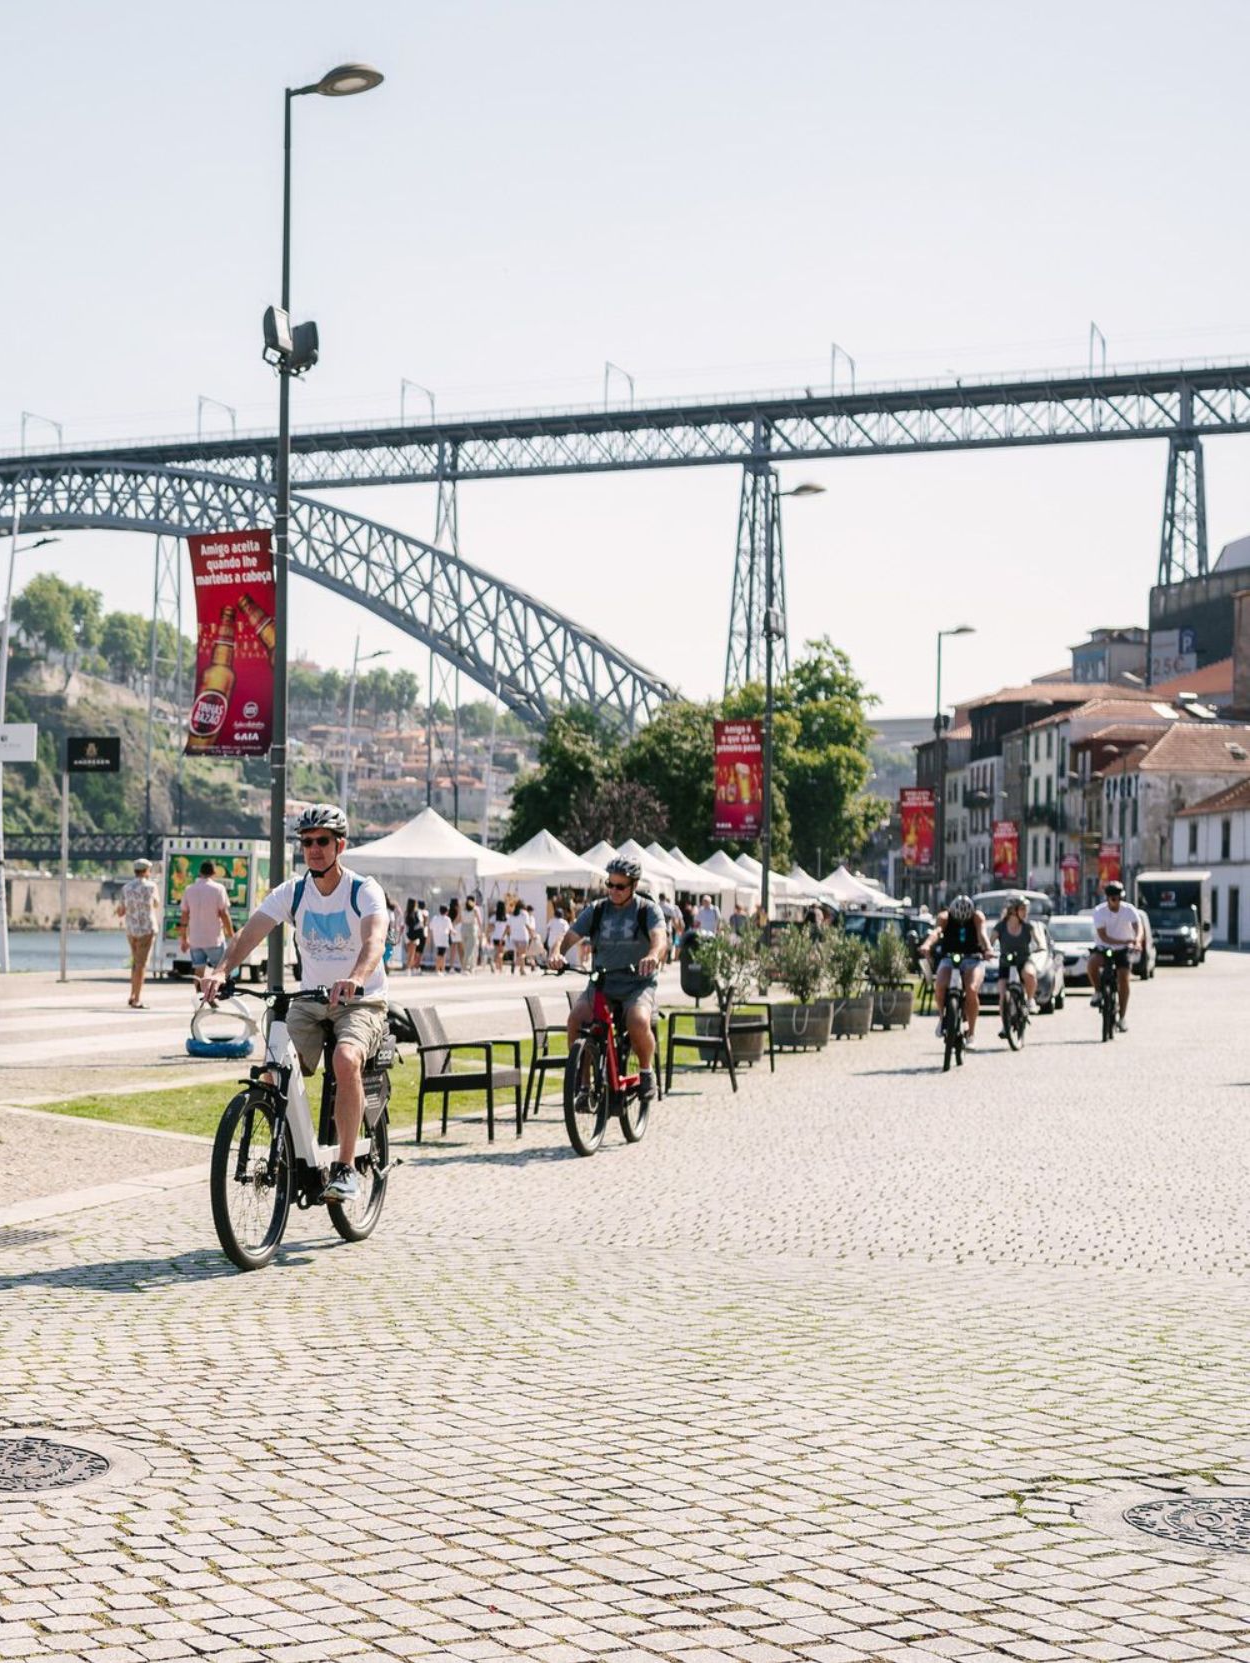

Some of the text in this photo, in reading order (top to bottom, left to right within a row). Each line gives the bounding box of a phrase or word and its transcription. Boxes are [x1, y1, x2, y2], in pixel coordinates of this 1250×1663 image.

[201, 540, 260, 558] Amigo aceita
[206, 555, 258, 573] quando lhe
[195, 570, 272, 586] martelas a cabeça
[234, 732, 259, 740] GAIA
